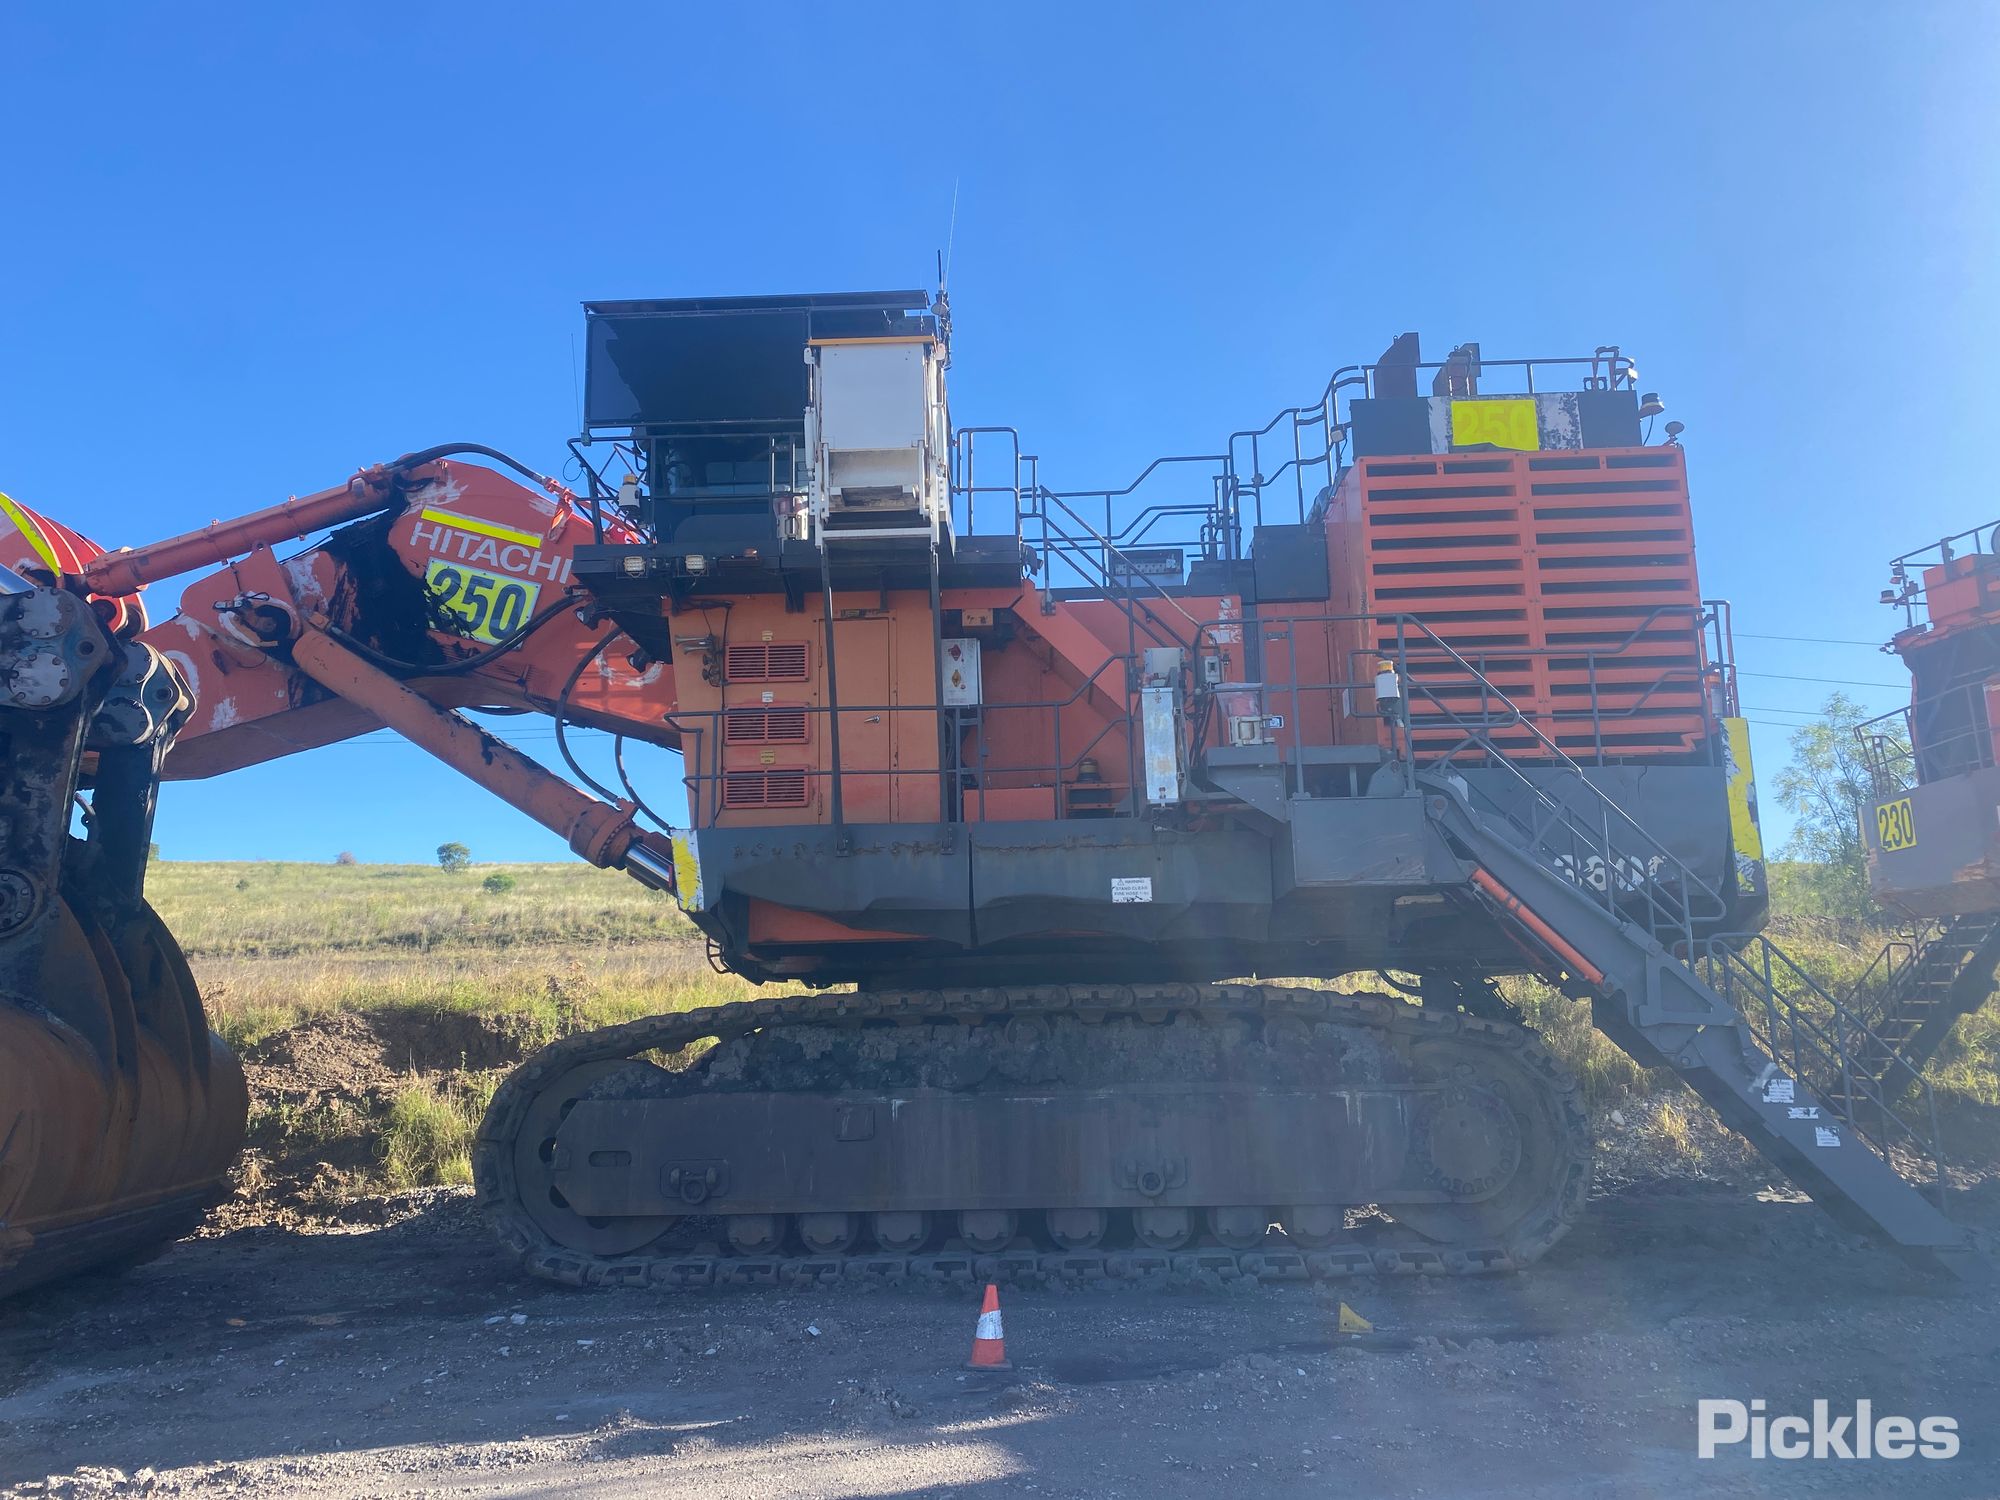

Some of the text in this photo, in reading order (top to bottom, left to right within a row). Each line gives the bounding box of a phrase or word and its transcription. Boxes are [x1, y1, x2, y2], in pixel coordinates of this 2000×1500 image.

[1454, 404, 1533, 448] 250
[410, 522, 573, 584] HITACHI
[427, 568, 527, 640] 250
[1879, 801, 1913, 848] 230
